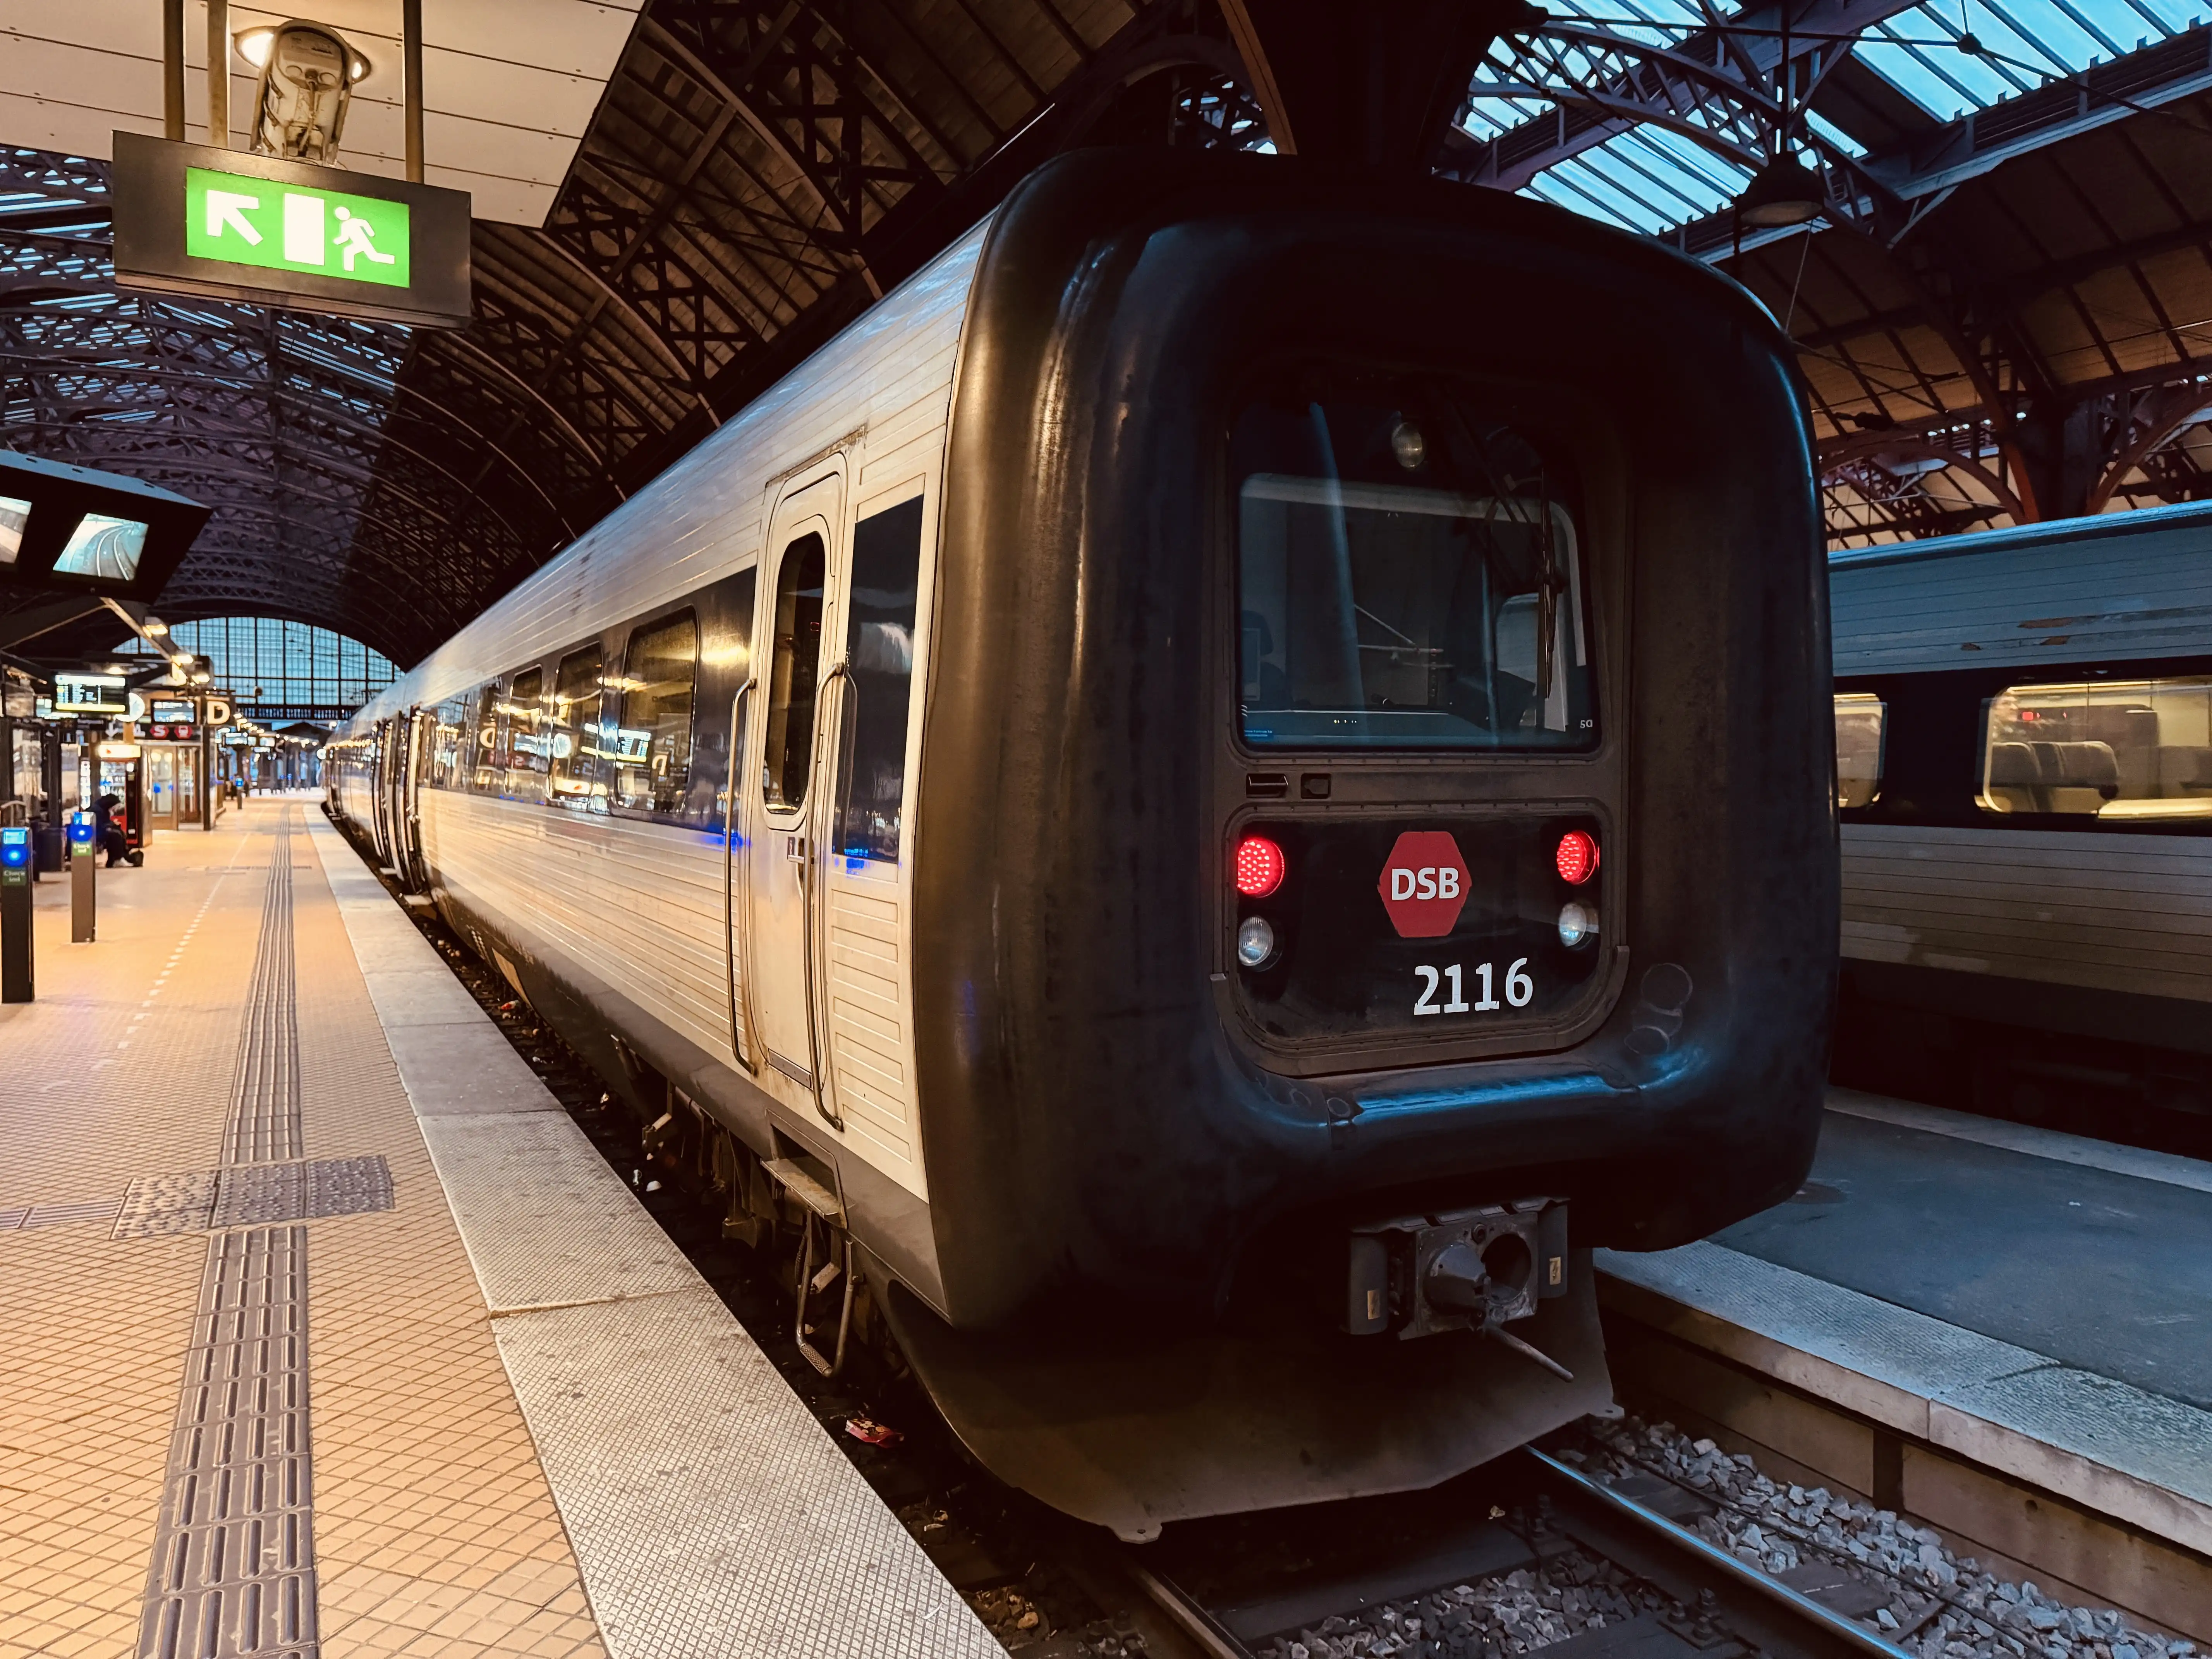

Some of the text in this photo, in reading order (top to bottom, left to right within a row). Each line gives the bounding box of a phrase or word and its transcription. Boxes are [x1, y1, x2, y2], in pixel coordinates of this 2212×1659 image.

[207, 701, 230, 724] D
[155, 725, 165, 736] S
[1391, 867, 1460, 900] DSB
[1413, 957, 1533, 1015] 2116
